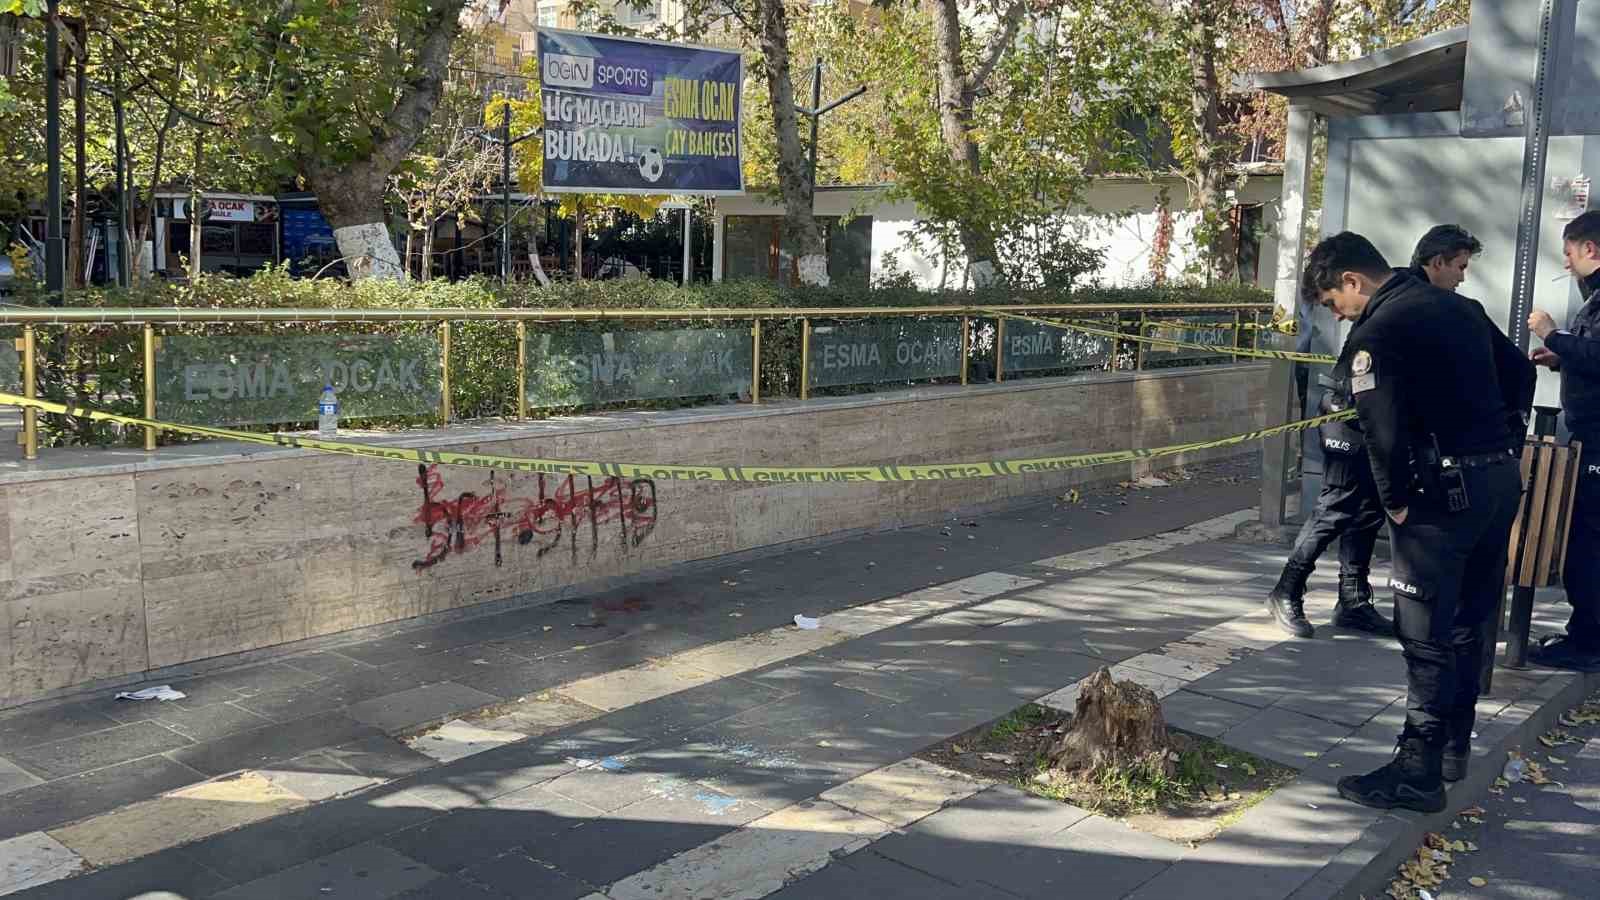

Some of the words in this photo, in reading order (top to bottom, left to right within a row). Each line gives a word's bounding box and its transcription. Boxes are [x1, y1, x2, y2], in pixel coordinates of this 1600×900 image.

[598, 65, 648, 88] SPORTS
[545, 91, 573, 122] LİG
[576, 98, 646, 129] MAÇLARI
[664, 76, 699, 119] ESMA
[702, 80, 736, 121] OCAK
[545, 129, 625, 163] BURADA
[665, 128, 687, 158] ÇAY
[688, 128, 736, 160] BAHÇESİ
[1011, 335, 1054, 356] ESMA
[1194, 328, 1224, 345] OCAK
[824, 343, 881, 368] ESMA
[184, 362, 296, 402] ESMA
[319, 357, 422, 394] OCAK
